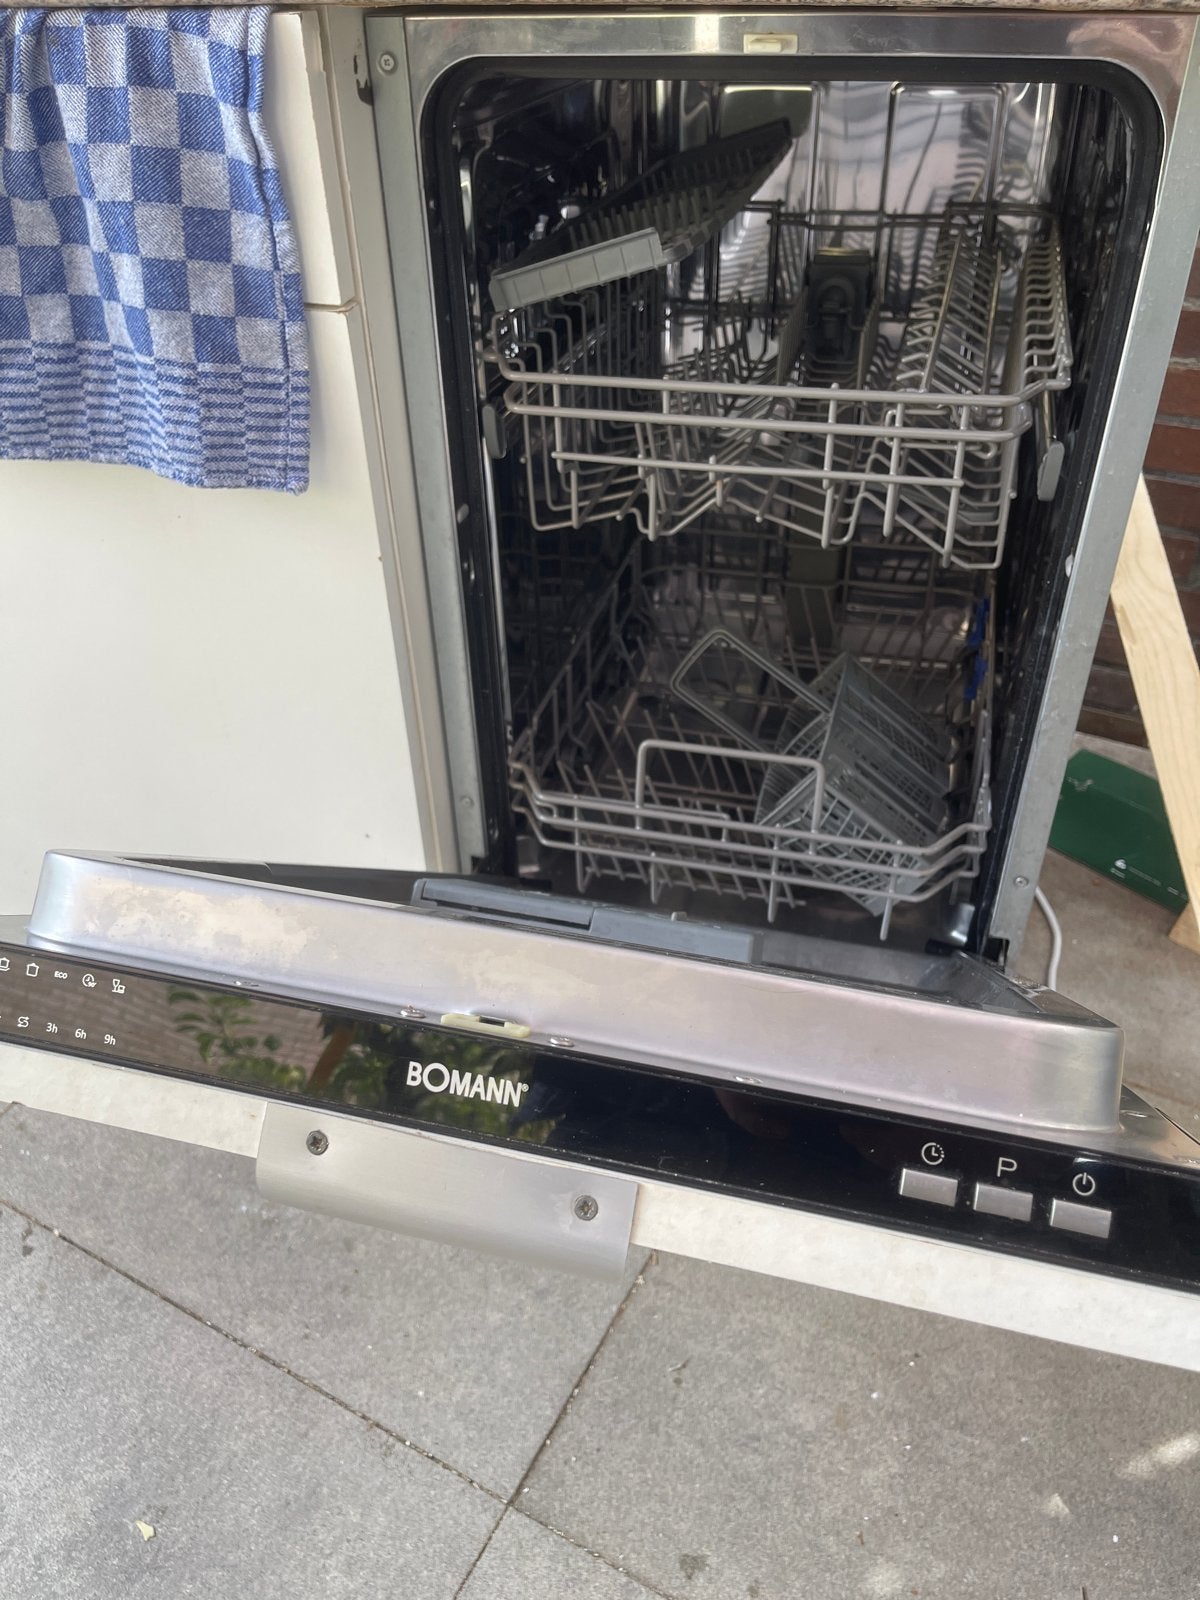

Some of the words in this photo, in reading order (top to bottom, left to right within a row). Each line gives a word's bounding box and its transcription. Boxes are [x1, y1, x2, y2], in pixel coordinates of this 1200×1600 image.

[46, 1022, 58, 1034] 3h
[75, 1028, 87, 1040] 6h
[104, 1034, 116, 1046] 9h
[997, 1156, 1018, 1178] P
